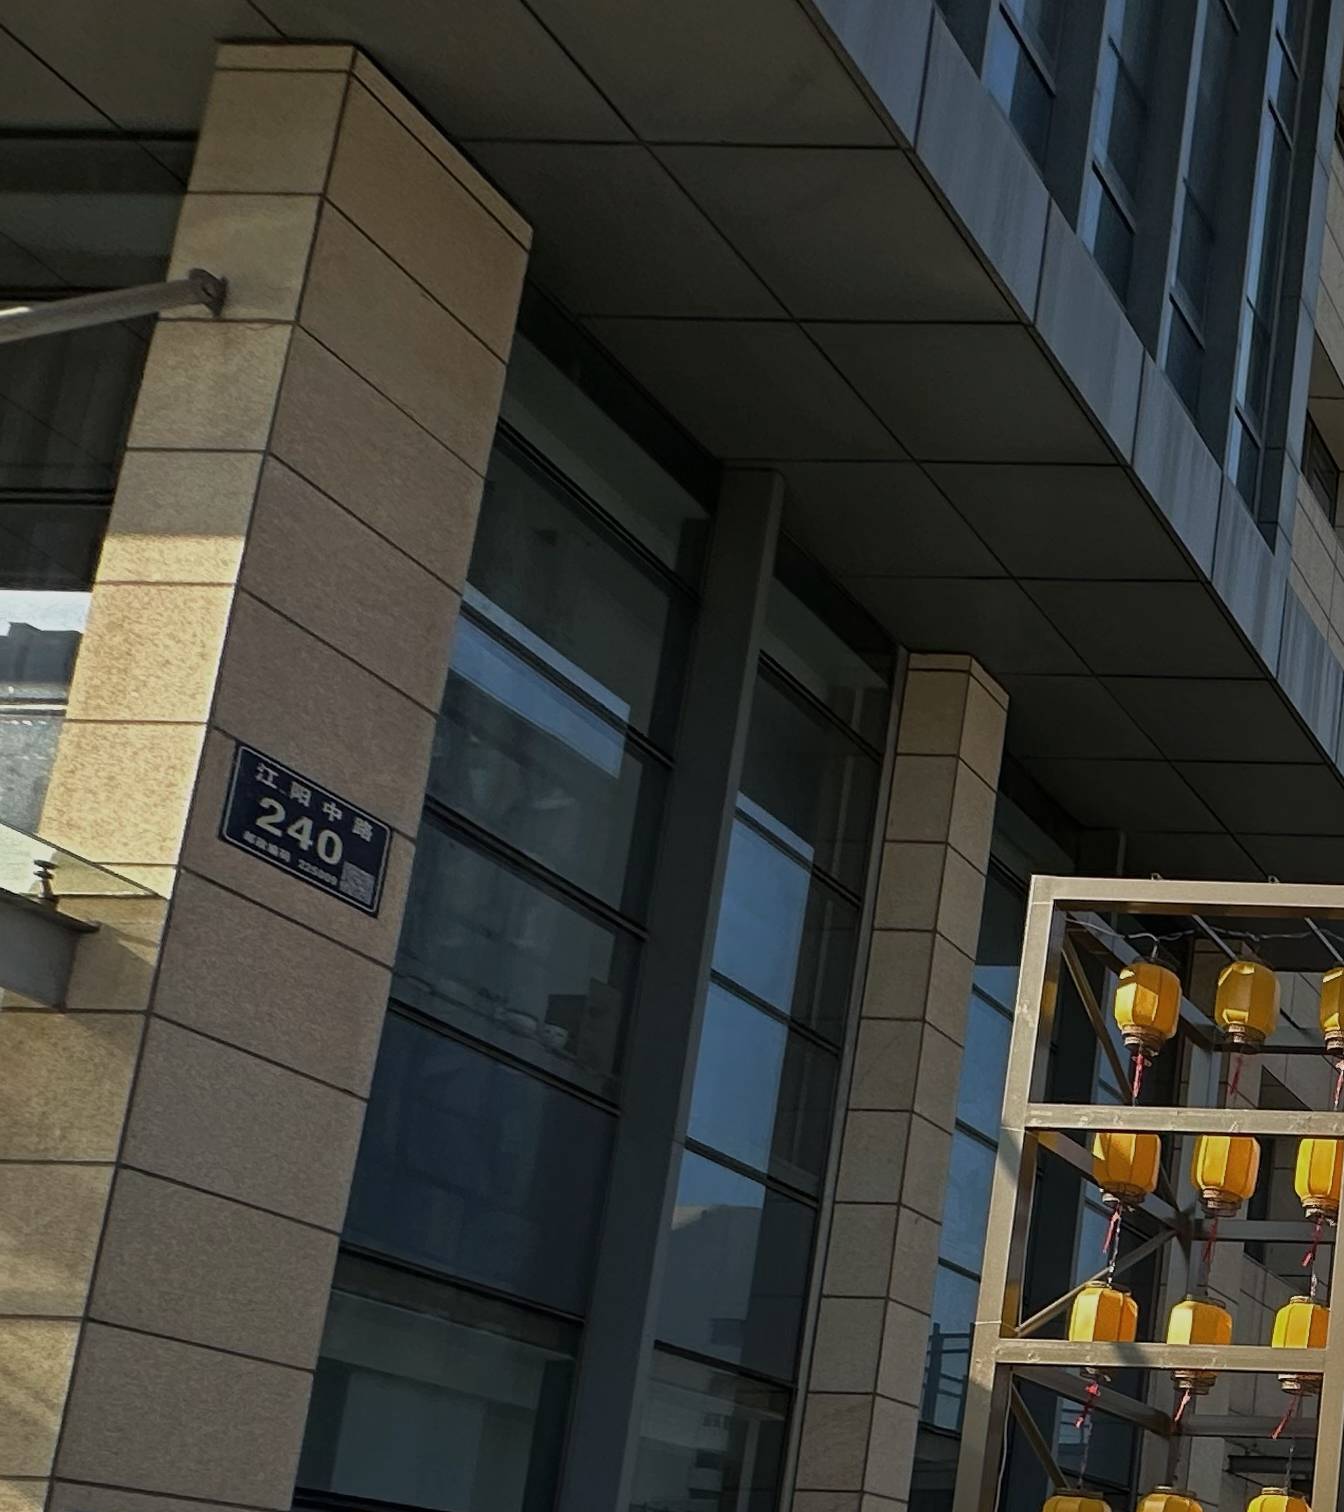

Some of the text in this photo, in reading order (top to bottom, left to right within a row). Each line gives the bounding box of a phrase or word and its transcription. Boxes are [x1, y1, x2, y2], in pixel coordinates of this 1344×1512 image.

[254, 762, 374, 843] 江阳中路
[255, 798, 344, 865] 240
